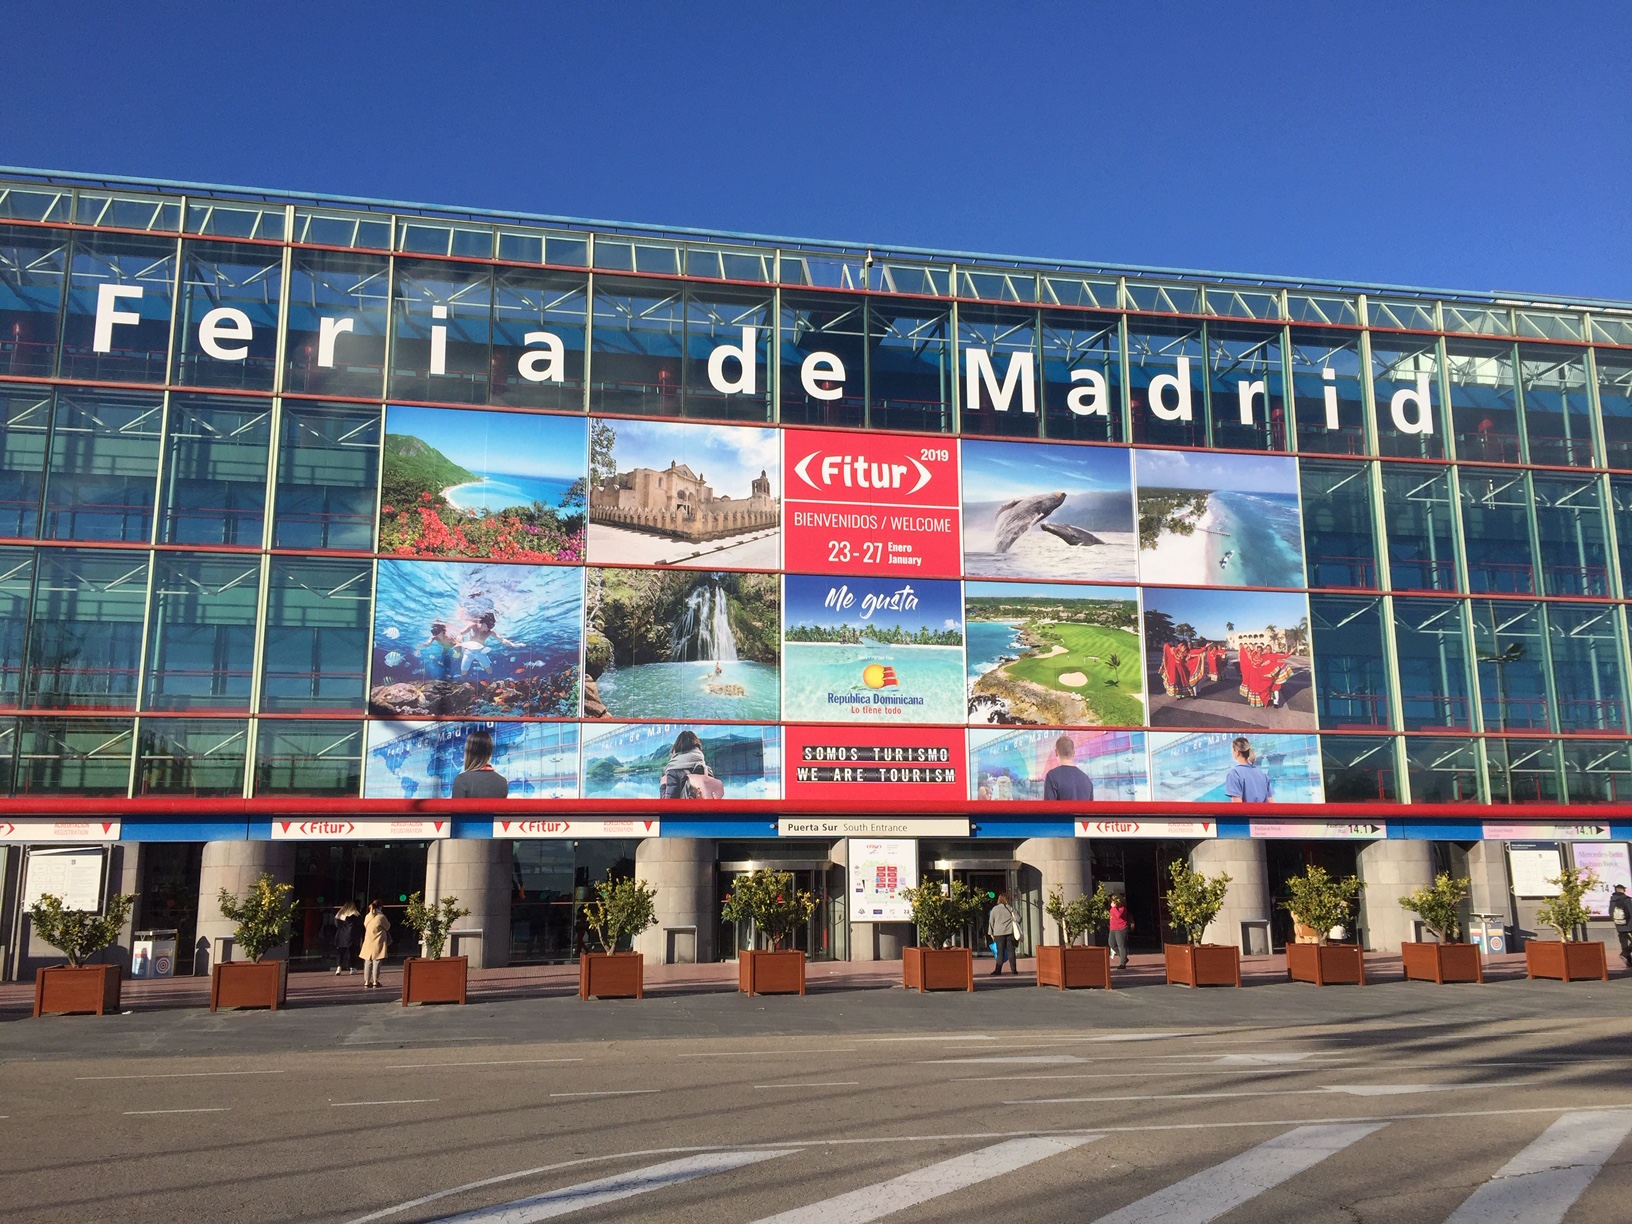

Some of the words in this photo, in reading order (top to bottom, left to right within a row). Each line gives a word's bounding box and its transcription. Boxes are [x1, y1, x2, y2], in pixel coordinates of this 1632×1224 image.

[93, 284, 565, 383] Feria
[708, 327, 845, 401] de
[965, 348, 1434, 435] Madrid
[921, 449, 949, 461] 2019
[821, 455, 907, 488] Fitur
[794, 512, 878, 530] BIENVENIDOS
[890, 516, 951, 532] WELCOME
[888, 541, 912, 552] Enero
[888, 554, 922, 566] January
[825, 585, 856, 611] Me
[859, 585, 919, 620] gusta
[827, 692, 871, 705] República
[873, 693, 924, 705] Dominicana
[851, 706, 860, 714] Lo
[863, 706, 882, 714] tiene
[885, 706, 902, 715] todo
[804, 747, 858, 760] SOMOS
[873, 748, 948, 762] TURISMO
[797, 767, 818, 781] WE
[833, 768, 864, 782] ARE
[879, 768, 956, 782] TOURISM
[310, 821, 345, 834] Fitur
[529, 820, 561, 832] Fitur
[788, 823, 819, 832] Puerta
[822, 823, 838, 832] Sur
[843, 823, 868, 832] South
[871, 823, 907, 832] Entrance
[1104, 822, 1132, 832] Fitur
[1348, 824, 1368, 834] 14.1
[1575, 825, 1593, 835] 14.1
